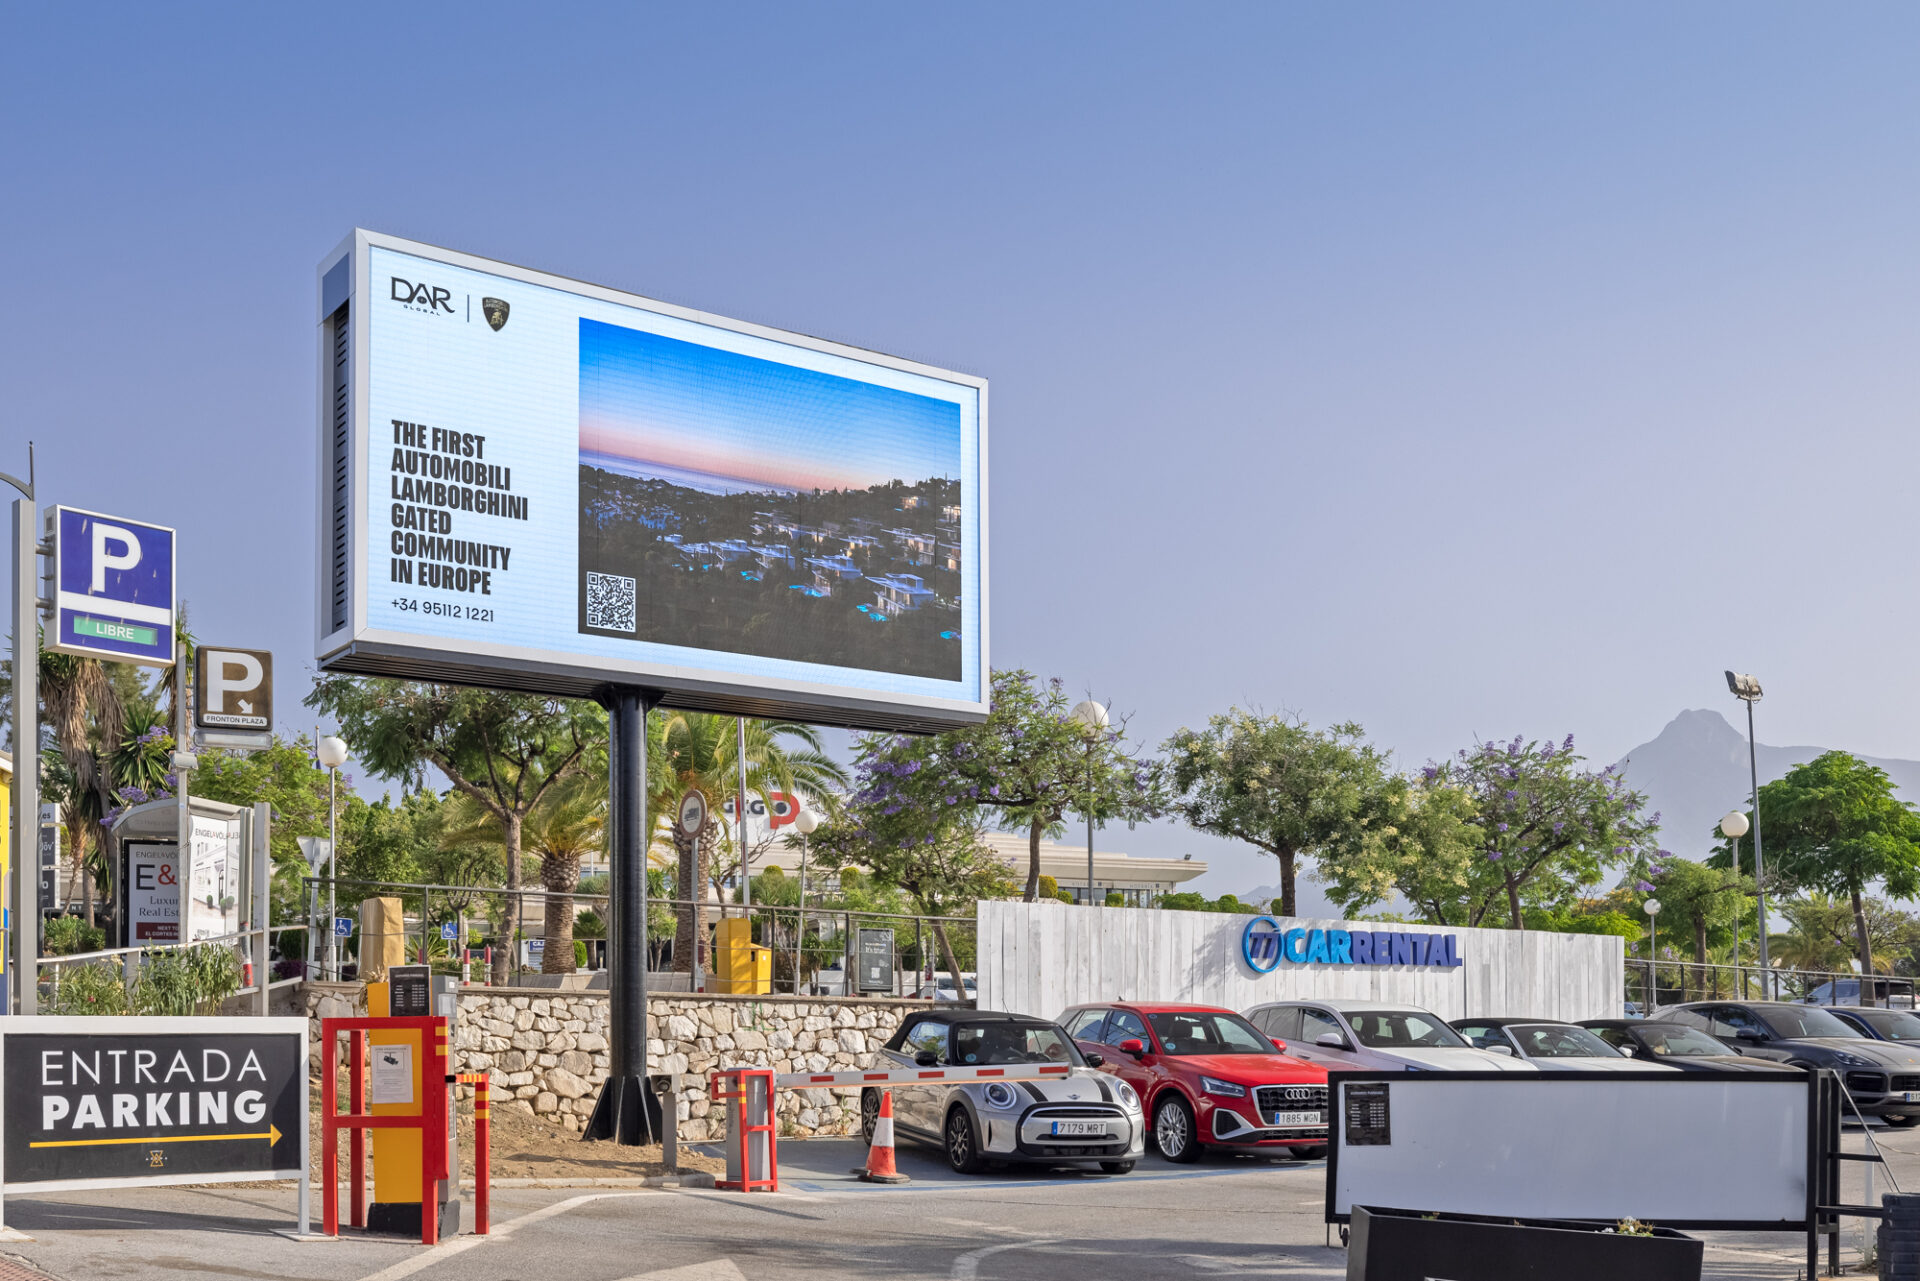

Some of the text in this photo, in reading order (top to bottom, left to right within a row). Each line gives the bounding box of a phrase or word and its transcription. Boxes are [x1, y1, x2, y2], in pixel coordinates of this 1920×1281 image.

[391, 276, 455, 313] DAR
[403, 304, 440, 316] GLOBAL
[391, 419, 485, 459] THE FIRST
[391, 447, 510, 491] AUTOMOBILI
[391, 475, 528, 521] LAMBORGHINI
[391, 503, 452, 535] GATED
[92, 522, 142, 593] P
[391, 530, 511, 571] COMMUNITY
[391, 557, 491, 595] IN EUROPE
[392, 598, 494, 622] +34 95112 1221
[96, 622, 134, 639] LIBRE
[207, 650, 263, 712] P
[206, 715, 240, 723] FRONTON
[136, 864, 179, 890] E&
[139, 907, 161, 917] Real
[150, 895, 179, 905] Luxur
[42, 1049, 267, 1086] ENTRADA
[42, 1090, 267, 1130] PARKING
[1281, 1112, 1319, 1123] 1885 MGN
[1059, 1123, 1105, 1134] 7179 MRT
